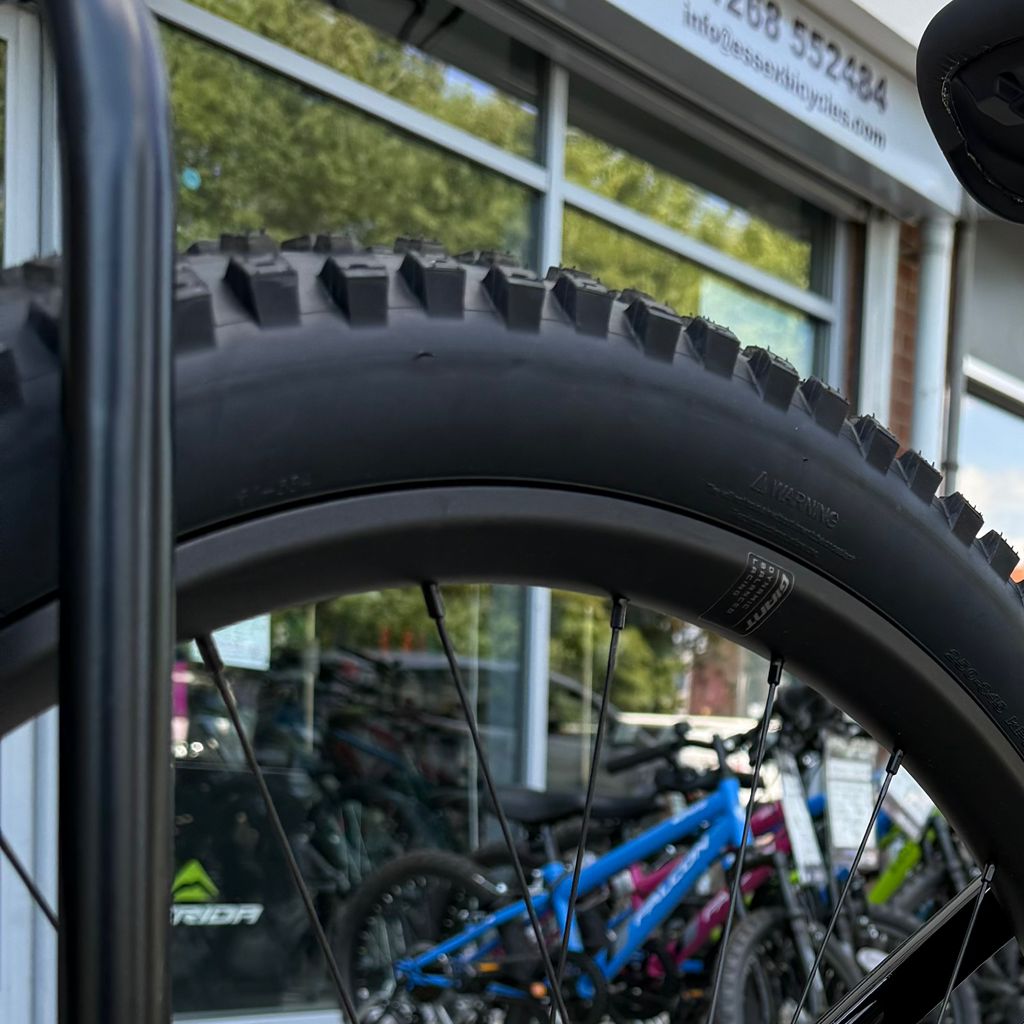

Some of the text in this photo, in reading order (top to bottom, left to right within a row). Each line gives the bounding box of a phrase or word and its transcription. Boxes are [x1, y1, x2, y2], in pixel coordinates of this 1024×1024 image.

[790, 16, 888, 114] 552484
[770, 479, 839, 528] WARNING
[745, 573, 790, 631] GIANT
[170, 903, 264, 926] RIDA
